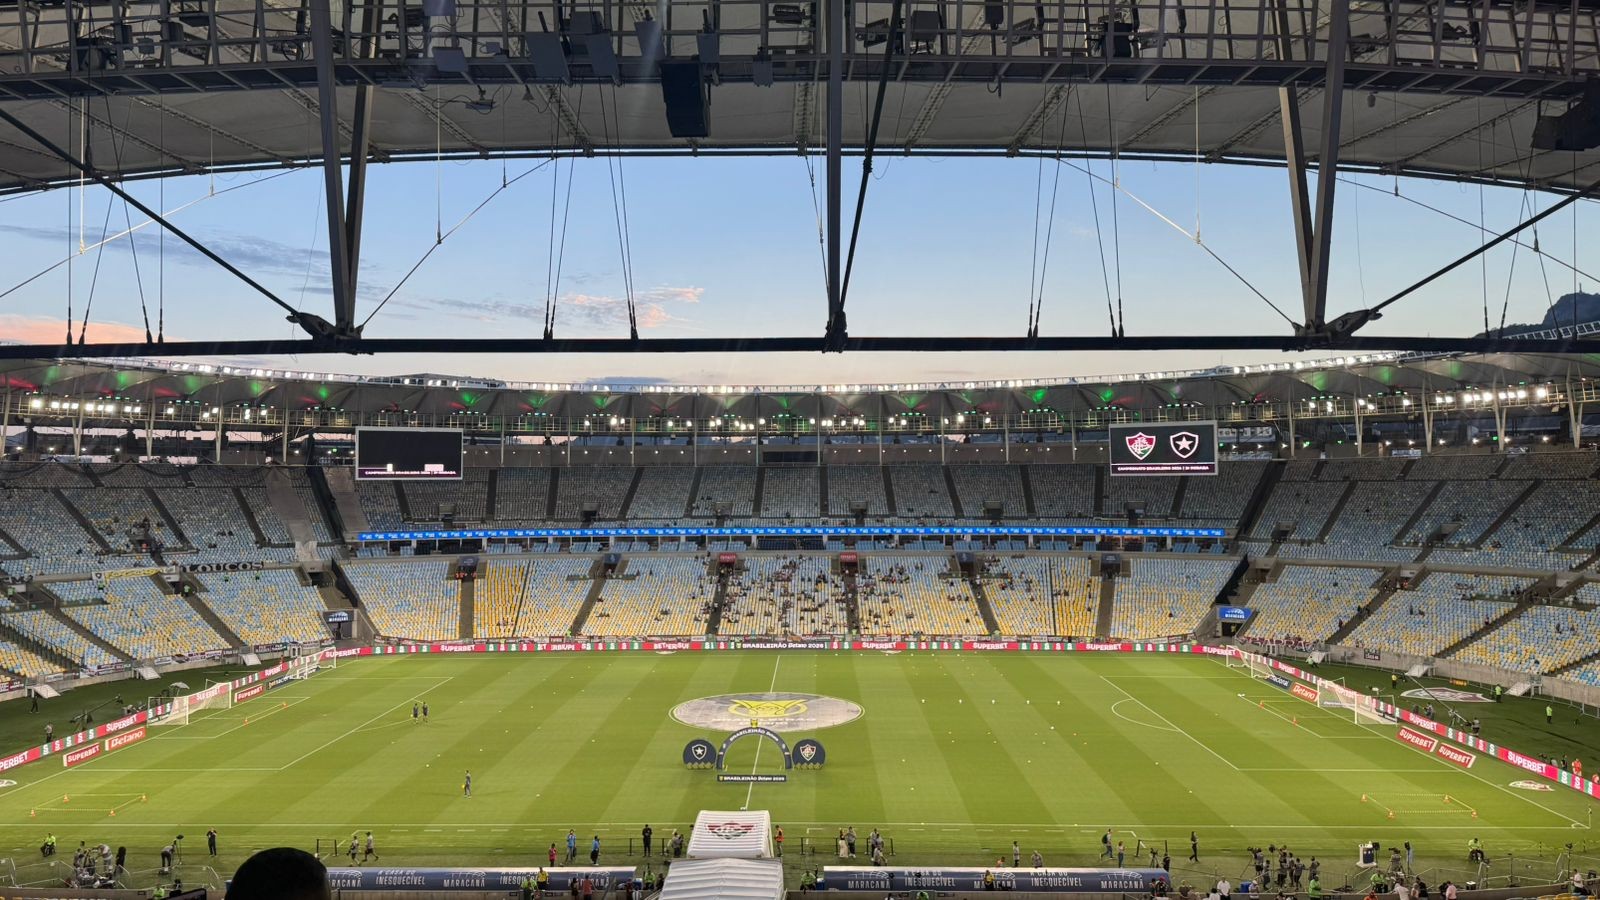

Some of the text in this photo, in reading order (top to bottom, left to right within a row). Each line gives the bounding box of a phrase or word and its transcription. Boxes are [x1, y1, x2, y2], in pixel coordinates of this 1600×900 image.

[862, 642, 896, 650] SUPERBET
[972, 642, 1008, 650] SUPERBET
[325, 648, 361, 658] SUPERBET
[1293, 684, 1315, 700] Betano
[106, 714, 138, 732] SUPERBET
[1409, 712, 1437, 731] SUPERBET
[111, 730, 143, 746] Betano
[1400, 729, 1433, 748] SUPERBET
[67, 745, 100, 763] SUPERBET
[1439, 746, 1470, 764] SUPERBET
[1508, 751, 1546, 774] SUPERBET
[376, 876, 425, 885] INESQUECÍVEL
[443, 878, 485, 887] MARACANÃ
[848, 879, 890, 889] MARACANÃ
[905, 877, 956, 886] INESQUECÍVEL
[1031, 877, 1082, 887] INESQUECÍVEL
[1101, 879, 1144, 889] MARACANÃ
